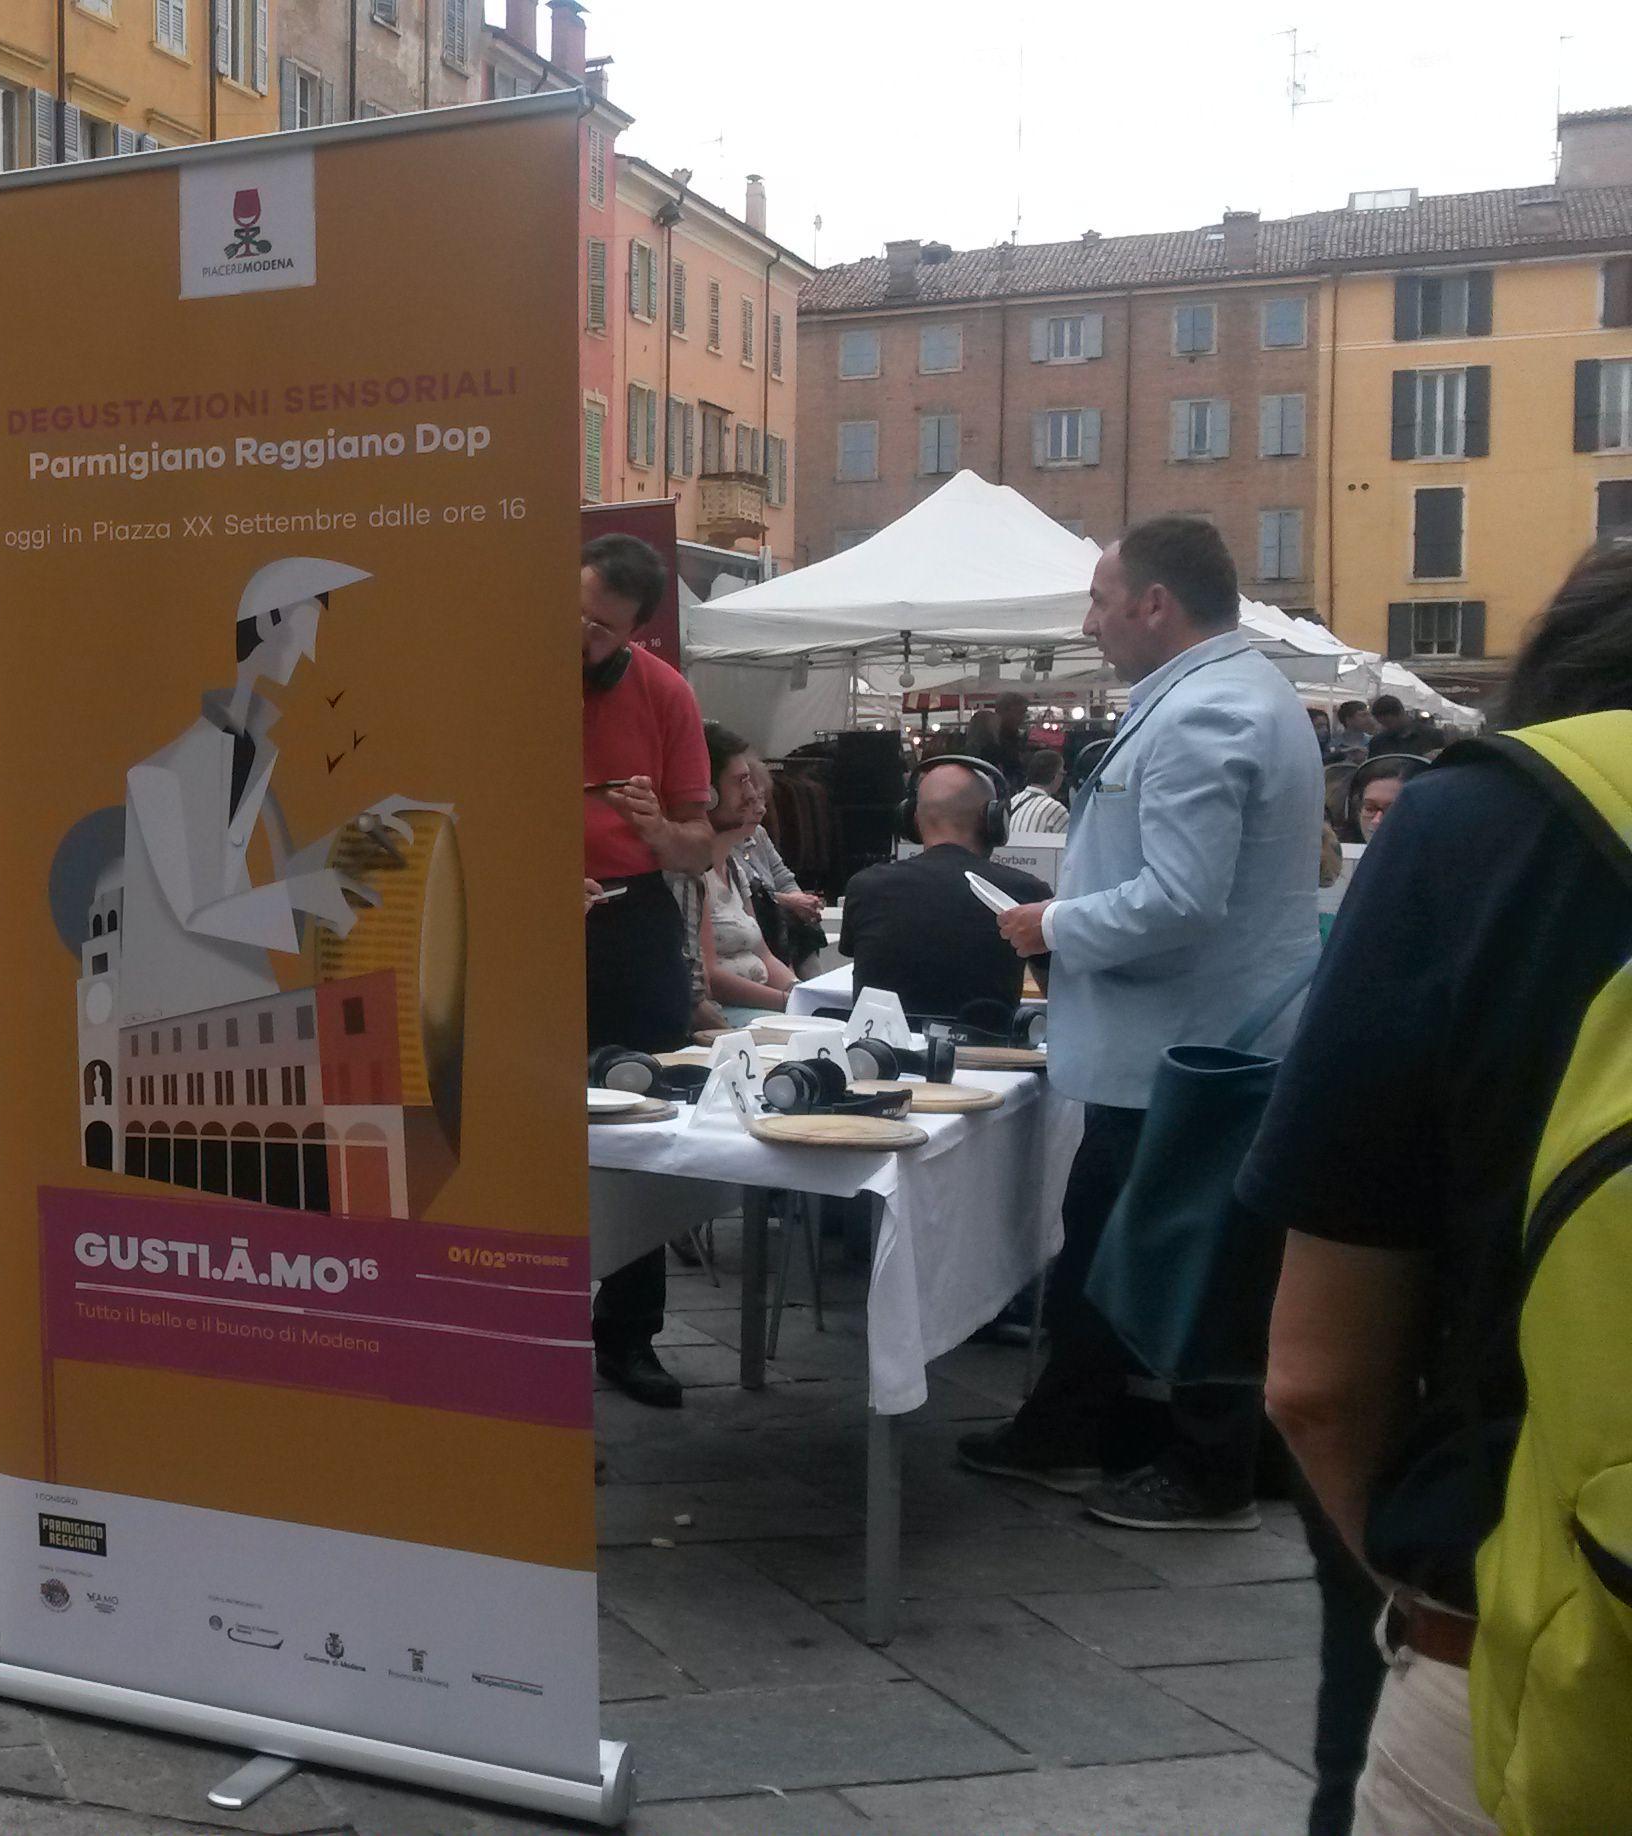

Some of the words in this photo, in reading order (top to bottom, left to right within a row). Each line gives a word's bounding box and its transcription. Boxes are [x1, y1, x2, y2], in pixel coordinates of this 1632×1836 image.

[7, 389, 268, 435] DEGUSTAZIONI
[284, 366, 517, 413] SENSORIALI
[29, 441, 226, 481] Parmigiano
[235, 428, 406, 471] Reggiano
[415, 423, 491, 457] Dop
[5, 524, 51, 550] oggi
[62, 522, 83, 544] in
[93, 520, 171, 542] Piazza
[182, 515, 214, 537] XX
[224, 508, 357, 536] Settembre
[368, 502, 431, 528] dalle
[443, 504, 487, 523] ore
[498, 497, 527, 521] 16
[738, 1049, 756, 1080] 2
[731, 1081, 747, 1114] 5
[75, 1301, 121, 1321] Tutto
[126, 1305, 136, 1322] il
[140, 1307, 182, 1329] bello
[186, 1318, 198, 1330] e
[201, 1312, 212, 1331] il
[216, 1316, 274, 1340] buono
[279, 1324, 297, 1344] di
[302, 1328, 380, 1353] Modena
[42, 1517, 104, 1540] PARMIGIANO
[48, 1531, 98, 1552] REGGIANO
